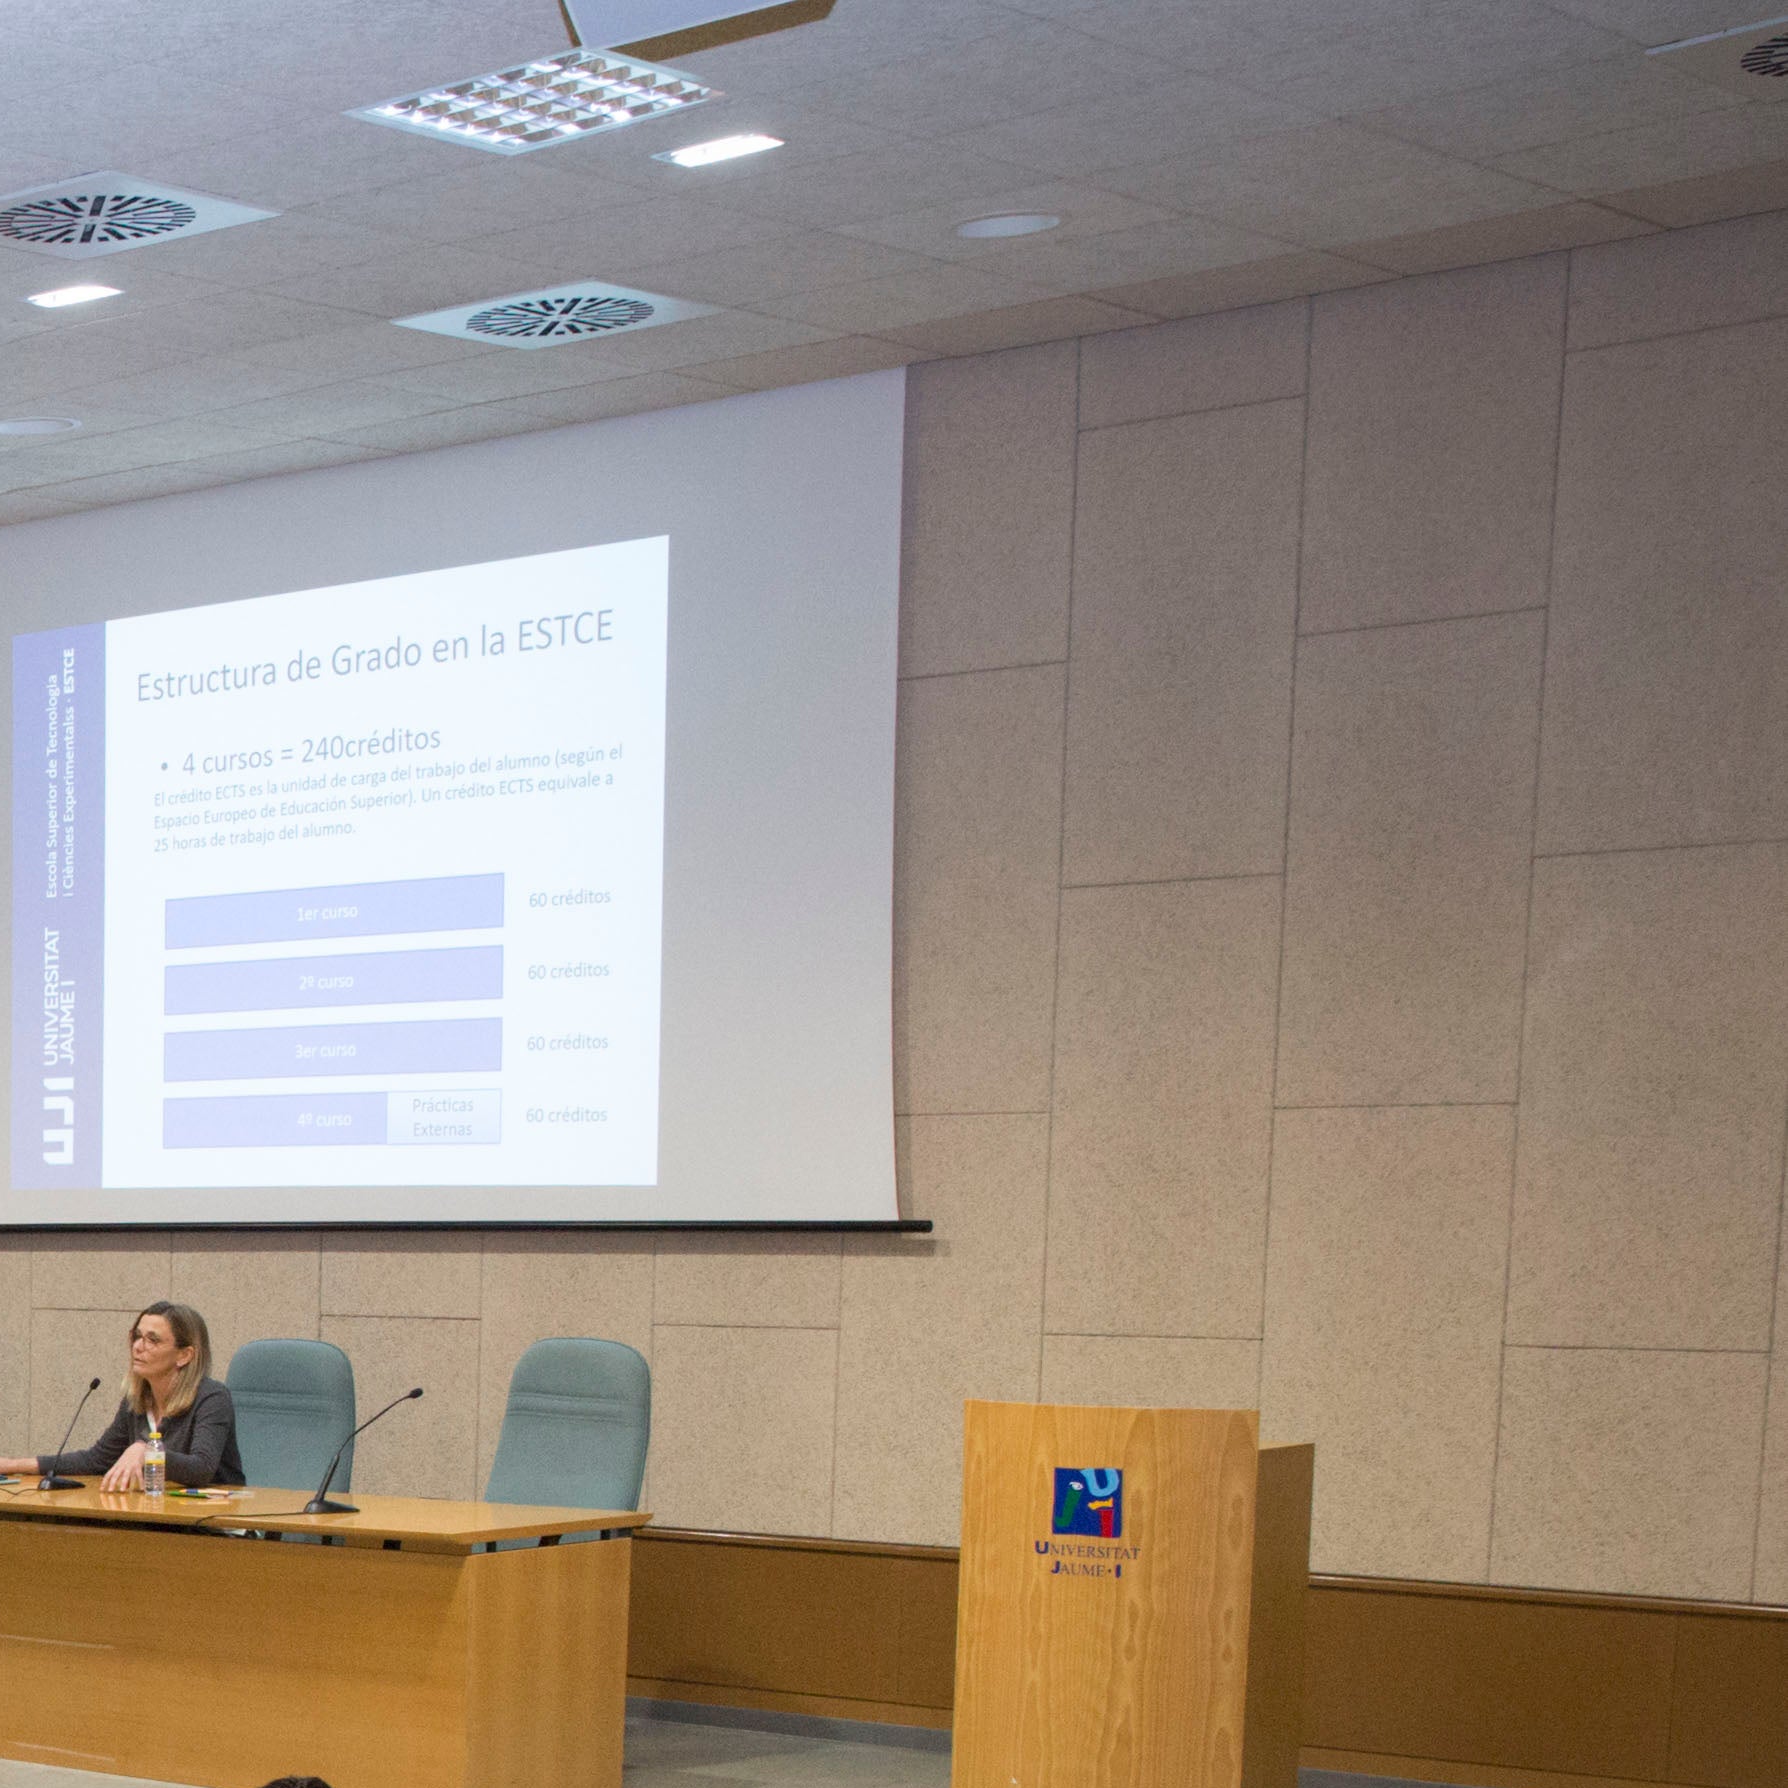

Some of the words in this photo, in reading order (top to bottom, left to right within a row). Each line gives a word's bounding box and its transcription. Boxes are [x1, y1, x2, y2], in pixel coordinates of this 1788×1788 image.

[137, 662, 277, 702] Estructura
[287, 650, 322, 682] de
[331, 636, 422, 677] Grado
[432, 633, 470, 663] en
[481, 625, 505, 656] la
[519, 608, 614, 652] ESTCE
[63, 648, 74, 693] ESTCE
[46, 674, 60, 757] Tecnologia
[182, 752, 195, 775] 4
[203, 749, 273, 774] cursos
[281, 749, 293, 760] =
[301, 728, 441, 764] 240créditos
[46, 758, 57, 779] de
[154, 792, 166, 807] El
[168, 788, 211, 805] crédito
[215, 784, 245, 800] ECTS
[249, 784, 263, 796] es
[267, 781, 277, 795] la
[281, 774, 325, 792] unidad
[330, 772, 346, 788] de
[351, 769, 385, 787] carga
[391, 764, 411, 781] del
[415, 761, 465, 779] trabajo
[469, 757, 491, 774] del
[495, 755, 550, 771] alumno
[555, 746, 604, 768] (según
[609, 742, 622, 760] el
[154, 812, 199, 831] Espacio
[204, 808, 256, 828] Europeo
[260, 801, 276, 818] de
[280, 797, 346, 816] Educación
[350, 790, 416, 810] Superior).
[421, 788, 440, 802] Un
[445, 782, 495, 800] crédito
[499, 777, 534, 796] ECTS
[538, 771, 600, 792] equivale
[605, 772, 614, 785] a
[46, 782, 60, 848] Superior
[154, 838, 168, 852] 25
[173, 834, 206, 850] horas
[210, 832, 225, 847] de
[229, 828, 274, 845] trabajo
[278, 824, 298, 840] del
[302, 821, 356, 837] alumno.
[46, 851, 57, 898] Escola
[529, 893, 547, 908] 60
[551, 890, 611, 906] créditos
[296, 907, 319, 922] 1er
[322, 905, 358, 920] curso
[528, 964, 546, 980] 60
[550, 962, 610, 978] créditos
[318, 976, 354, 990] curso
[44, 928, 59, 1066] UNIVERSITAT
[60, 991, 74, 1064] JAUME
[295, 1045, 318, 1059] 3er
[320, 1044, 356, 1058] curso
[527, 1036, 545, 1051] 60
[549, 1034, 609, 1050] créditos
[412, 1098, 474, 1113] Prácticas
[526, 1108, 544, 1122] 60
[548, 1106, 608, 1122] créditos
[316, 1113, 352, 1127] curso
[413, 1122, 472, 1137] Externas
[1035, 1540, 1141, 1560] UNIVERSITAT
[1051, 1560, 1106, 1577] JAUME
